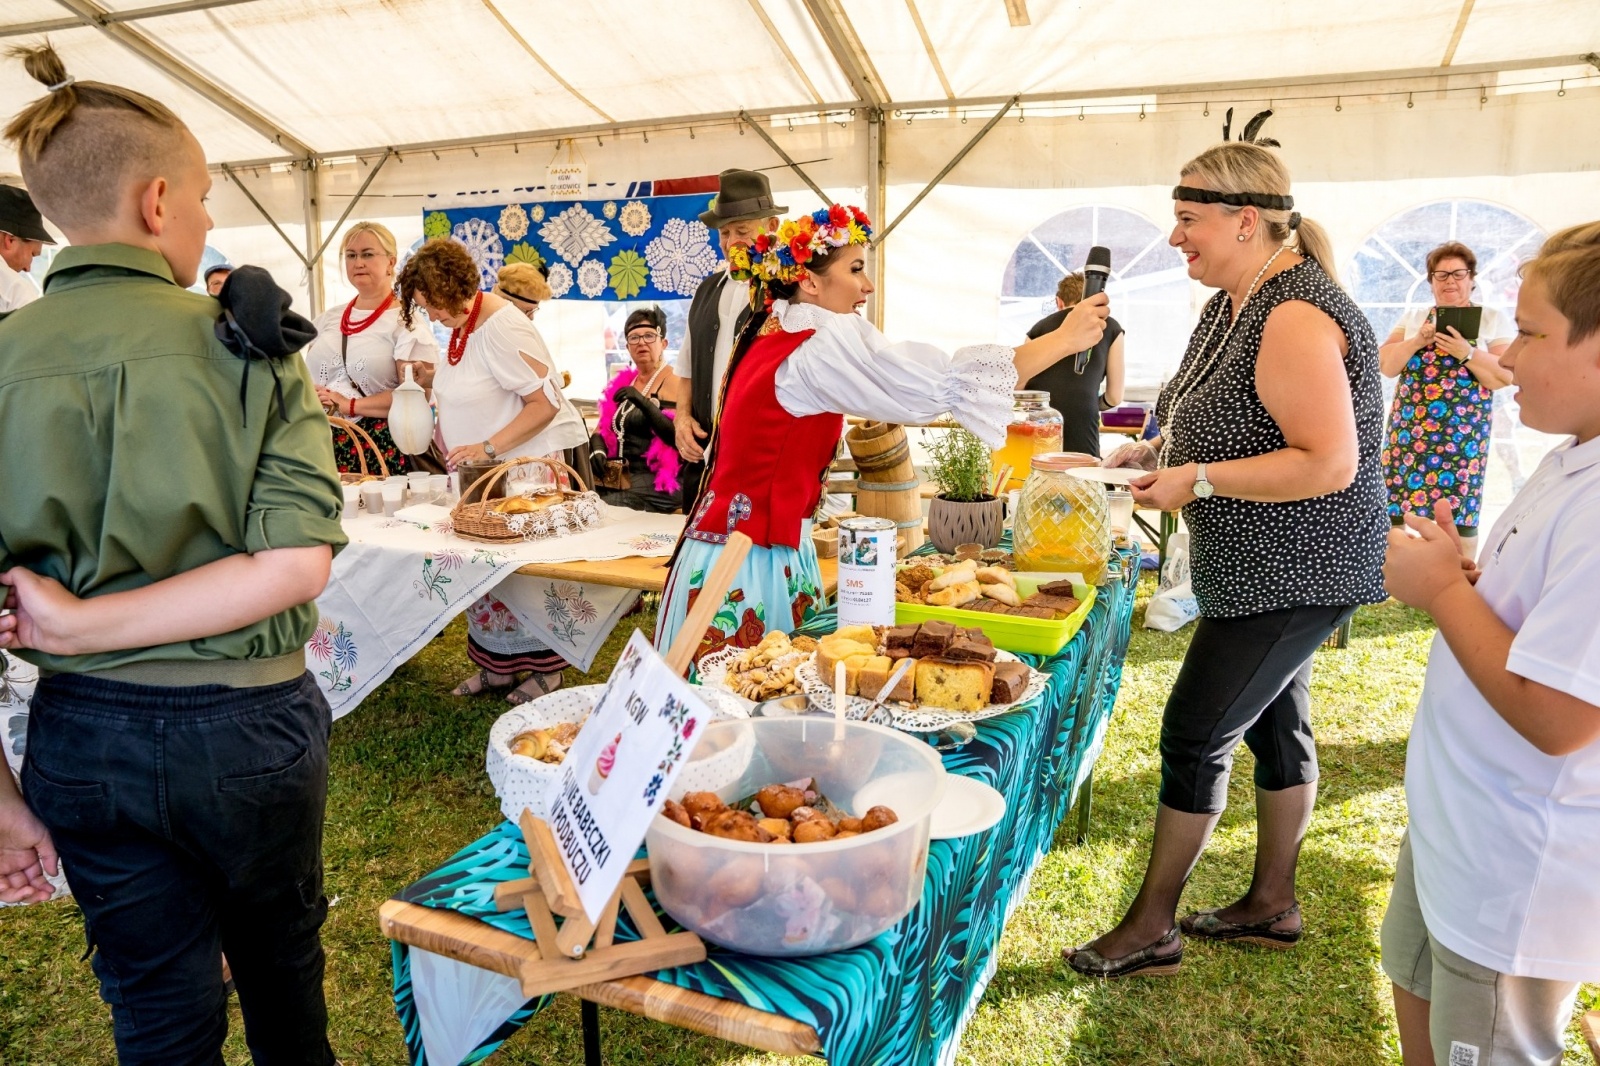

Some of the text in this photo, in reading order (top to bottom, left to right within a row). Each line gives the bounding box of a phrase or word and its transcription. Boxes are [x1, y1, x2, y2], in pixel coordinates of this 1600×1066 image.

[846, 578, 864, 588] SMS
[624, 690, 650, 726] KGW
[551, 793, 592, 886] W PODBUCZU
[562, 766, 612, 870] FAJNE BABECZKI
